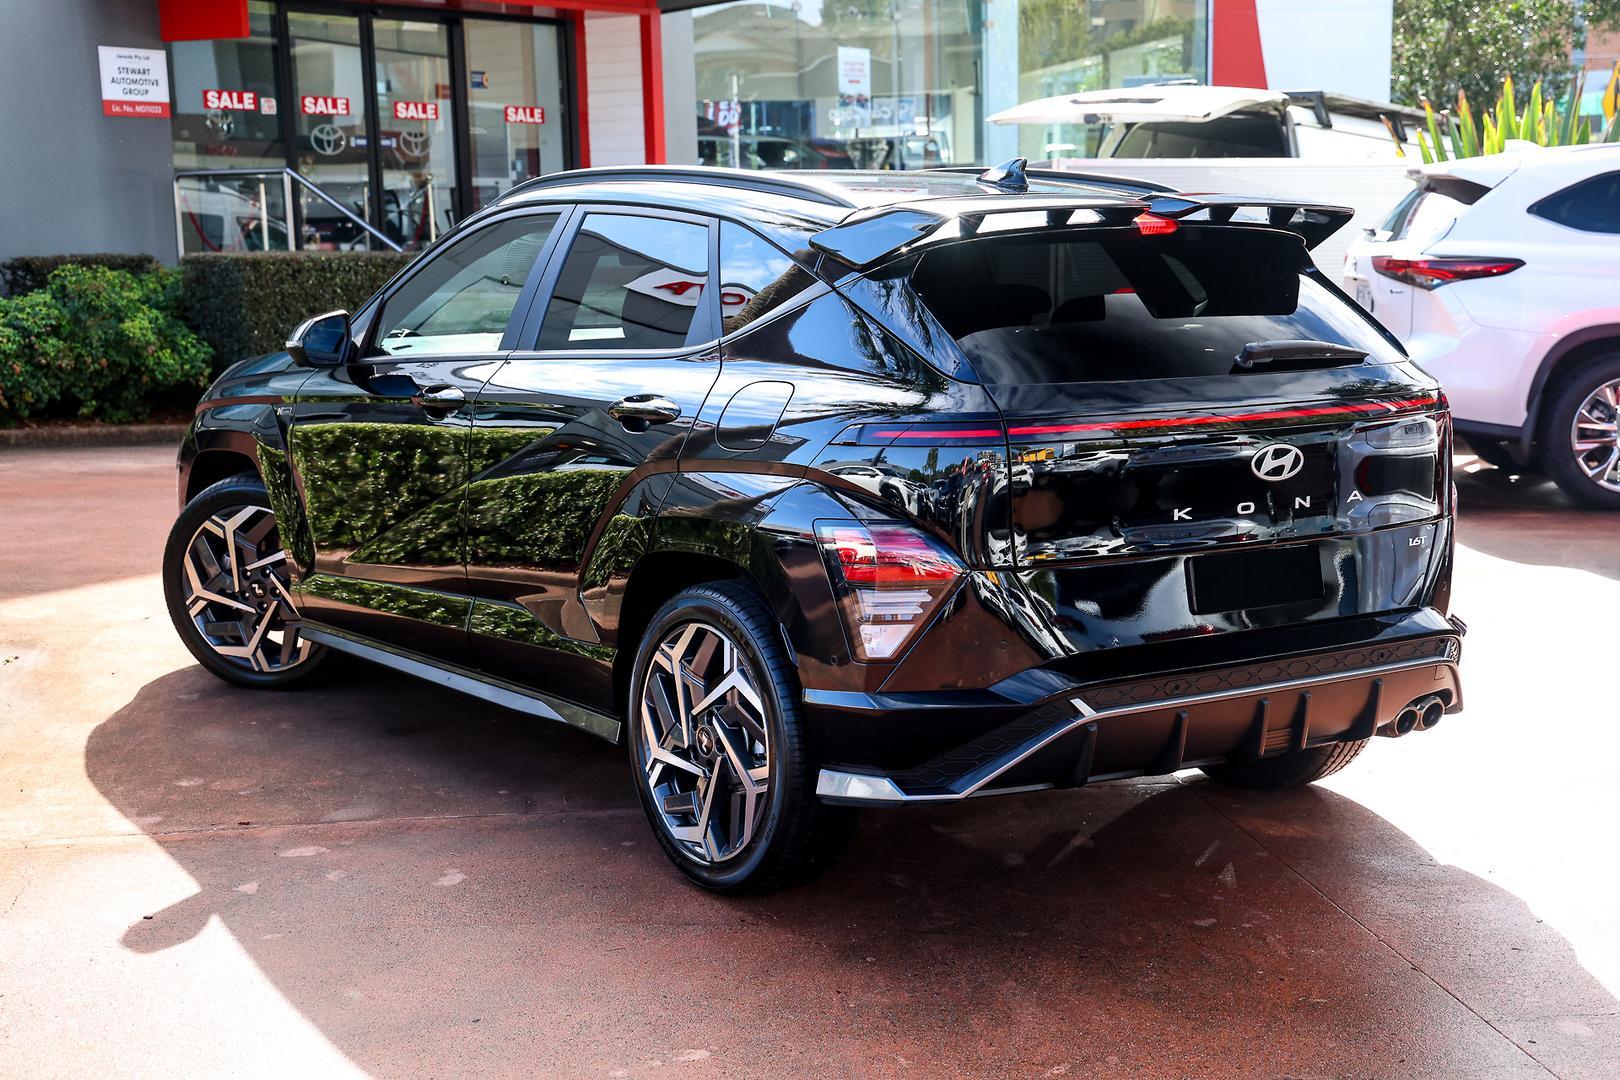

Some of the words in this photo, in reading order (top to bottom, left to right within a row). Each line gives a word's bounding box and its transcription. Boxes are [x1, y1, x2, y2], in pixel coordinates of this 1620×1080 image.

[117, 66, 150, 75] STEWART
[110, 77, 159, 87] AUTOMOTIVE
[122, 88, 149, 96] GROUP
[206, 90, 255, 110] SALE
[304, 97, 348, 115] SALE
[396, 102, 437, 120] SALE
[506, 106, 543, 123] SALE
[1173, 490, 1364, 521] KONA
